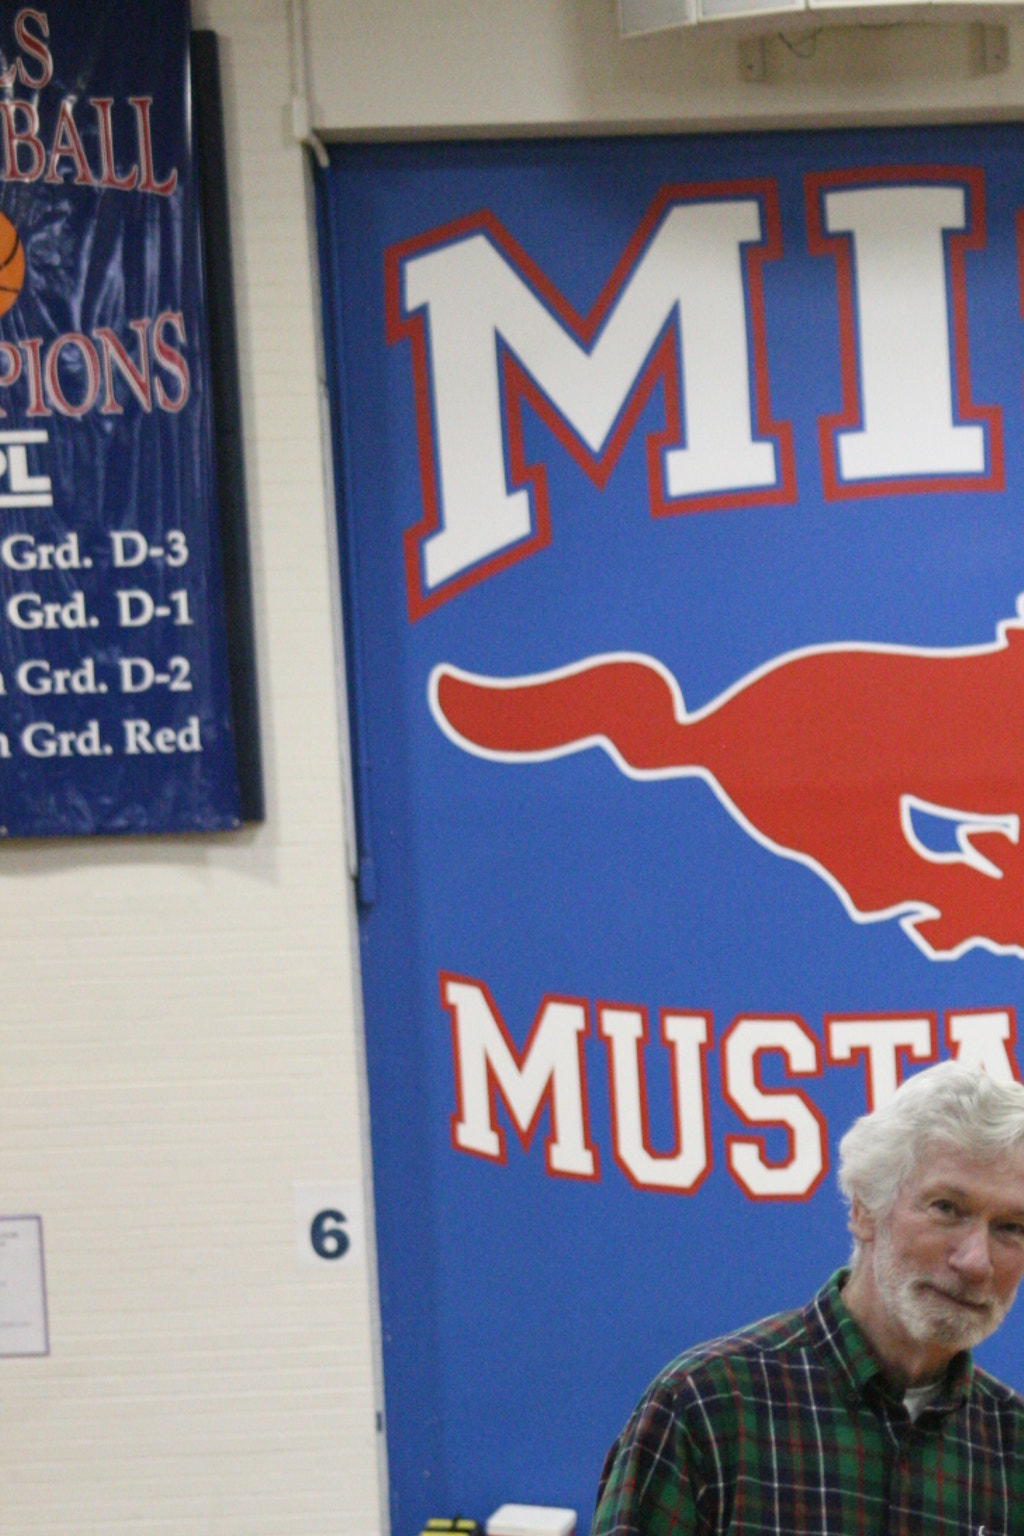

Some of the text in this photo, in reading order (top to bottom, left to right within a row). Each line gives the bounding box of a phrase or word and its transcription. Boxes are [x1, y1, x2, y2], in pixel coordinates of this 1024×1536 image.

[2, 530, 189, 571] Grd. D-3
[7, 589, 194, 630] Grd. D-1
[17, 658, 108, 695] Grd.
[119, 657, 193, 693] D-2
[22, 720, 113, 758] Grd.
[124, 716, 203, 754] Red
[309, 1208, 351, 1261] 6
